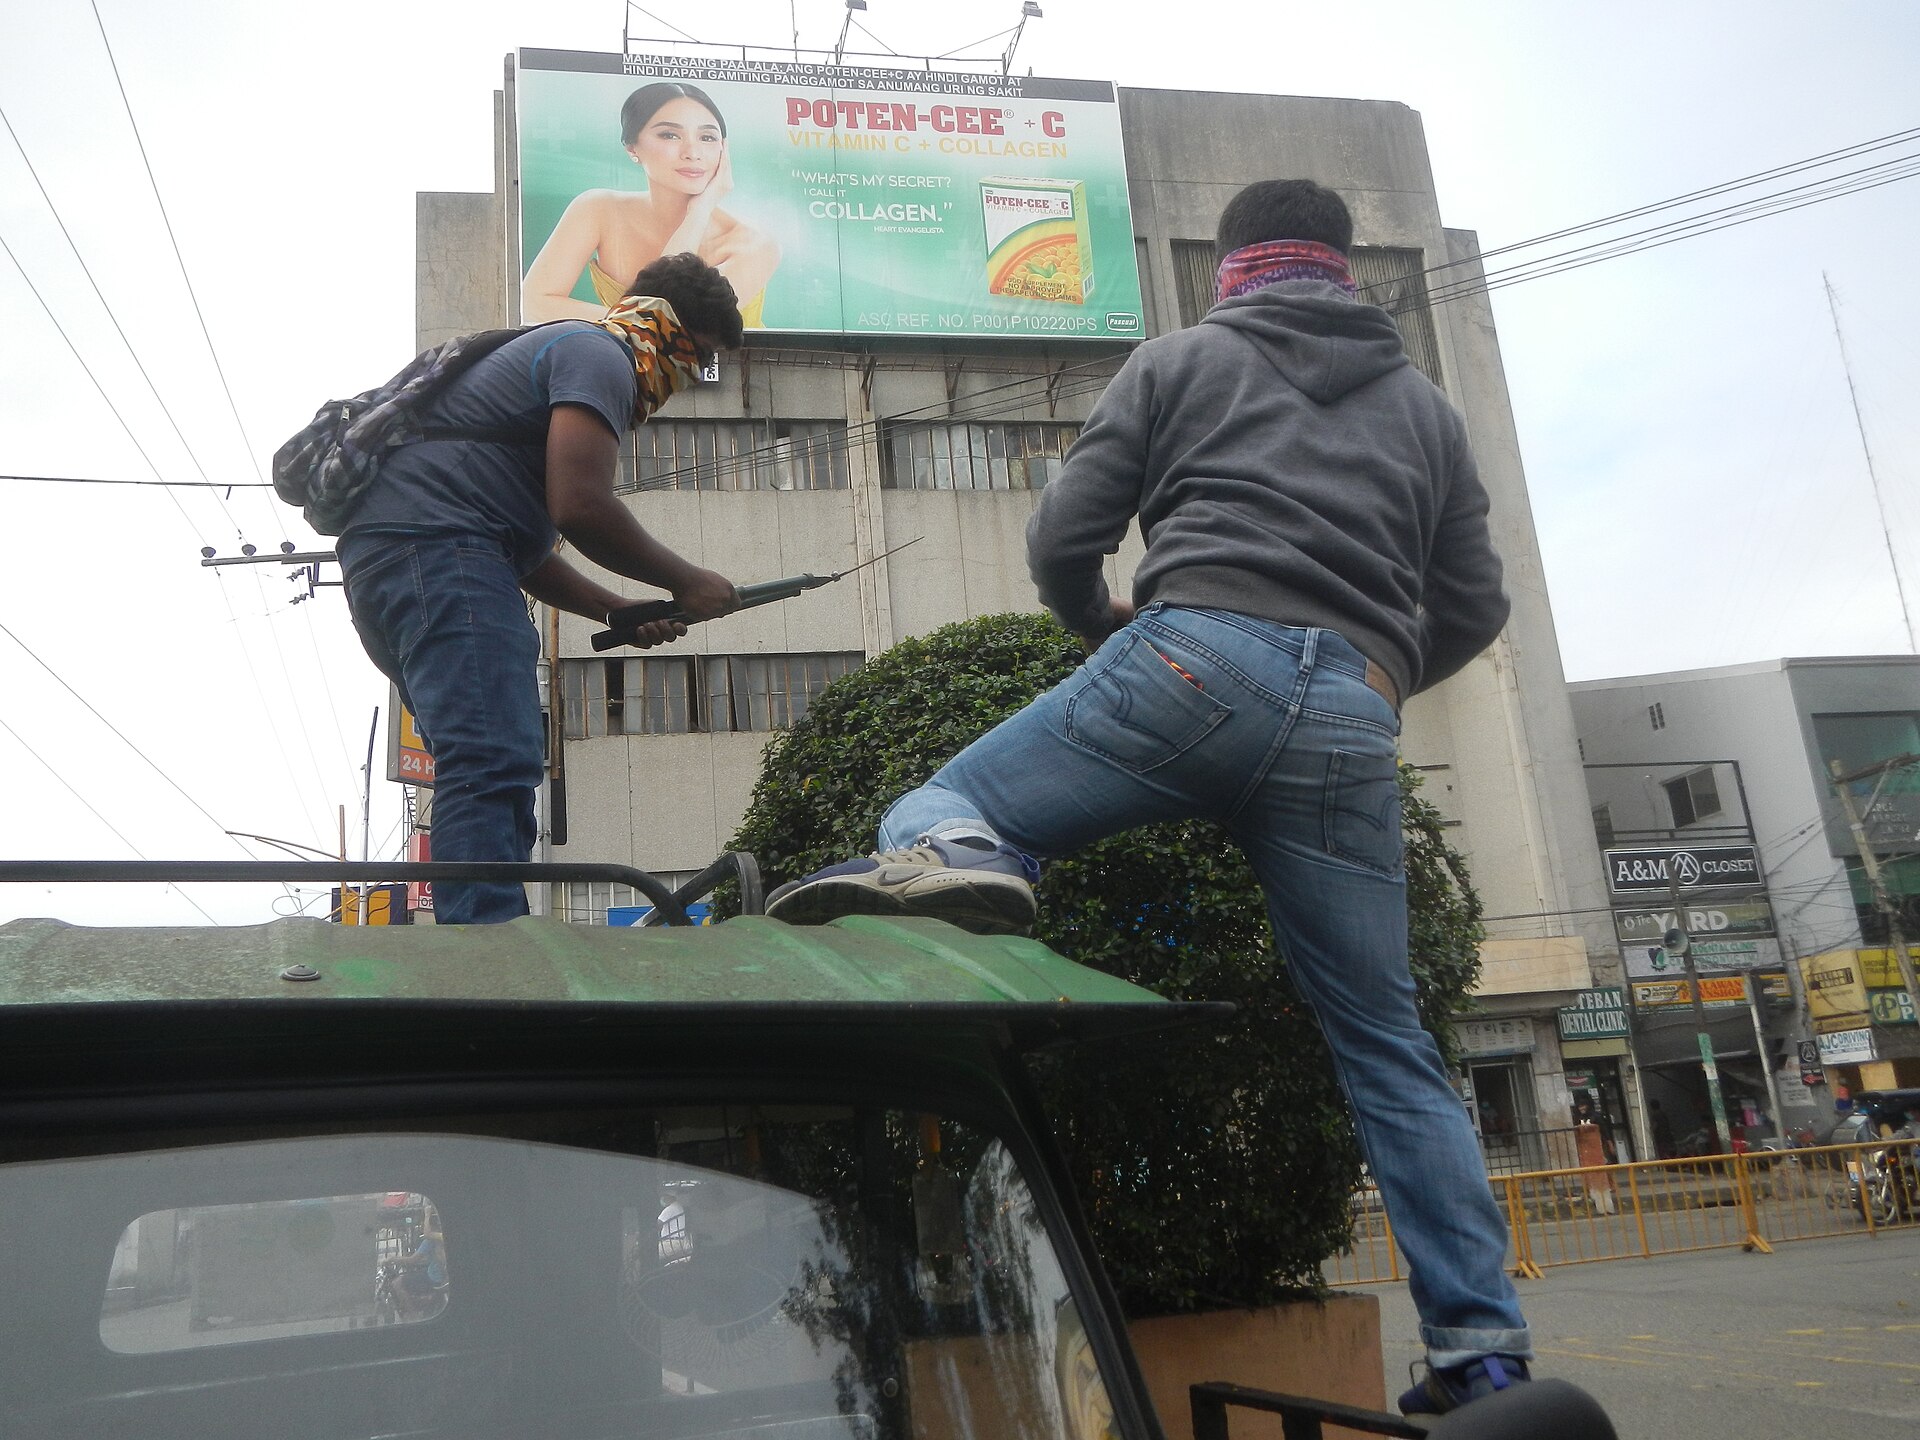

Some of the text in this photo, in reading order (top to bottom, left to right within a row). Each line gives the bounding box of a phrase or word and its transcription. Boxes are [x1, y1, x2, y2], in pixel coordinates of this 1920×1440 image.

[622, 53, 1022, 86] MAHALAGANG PAALALA: ANG POTEN-CEE+C AY HINDI GAMOT AT
[623, 64, 1024, 98] HINDI DAPAT GAMITING PANGGAMOT SA ANUMANG URI NG SAKIT
[1024, 118, 1036, 129] +
[1041, 110, 1066, 139] C
[788, 129, 1068, 159] VITAMIN C + COLLAGEN
[861, 174, 885, 186] MY
[888, 175, 951, 188] SECRET?
[808, 188, 835, 198] CALL
[836, 189, 846, 197] IT
[985, 195, 1050, 209] POTEN-CEE
[1060, 201, 1069, 210] C
[986, 204, 1015, 212] VITAMIN
[1029, 207, 1070, 216] COLLAGEN
[1022, 284, 1062, 293] APPROVED
[857, 311, 1097, 331] ASC REF. NO. P001P102220PS
[1109, 317, 1136, 327] Pascual
[403, 754, 421, 773] 24
[1616, 859, 1754, 882] A&M CLOSET
[1635, 914, 1651, 926] The
[1561, 991, 1622, 1010] TEBAN
[1561, 1011, 1627, 1034] DENTAL CLINIC
